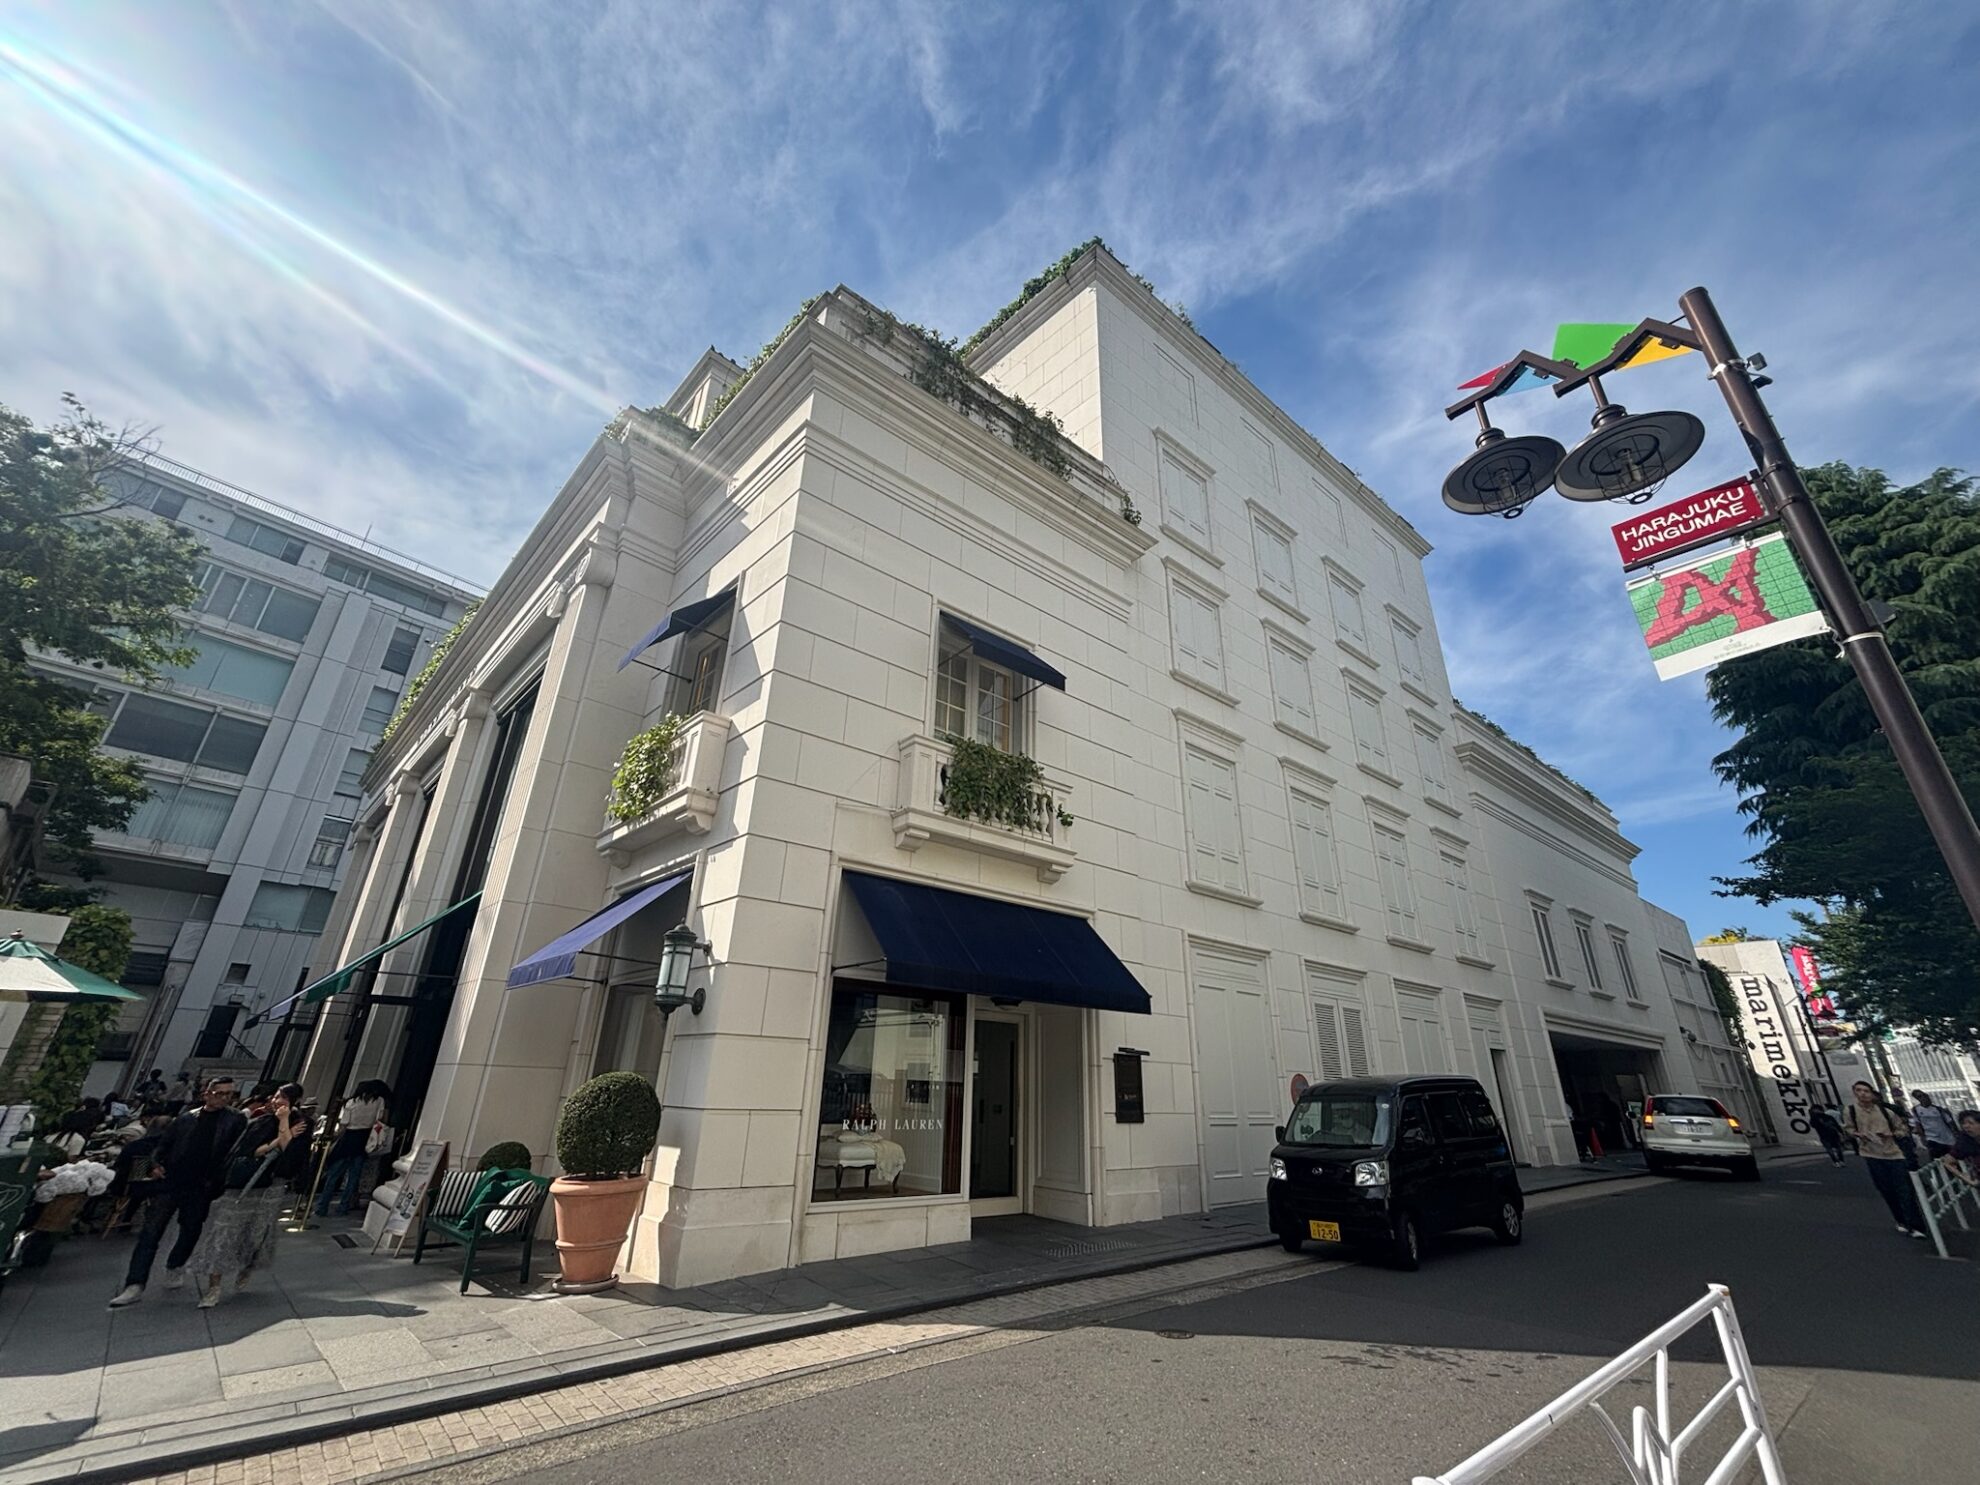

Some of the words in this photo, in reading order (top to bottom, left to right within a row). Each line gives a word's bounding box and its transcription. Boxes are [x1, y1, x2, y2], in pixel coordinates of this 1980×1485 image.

[1621, 487, 1745, 541] HARAJUKU
[1631, 502, 1747, 552] JINGUMAE
[1740, 977, 1811, 1135] marimekko
[842, 1118, 887, 1130] RALPH
[894, 1119, 943, 1130] LAUREN
